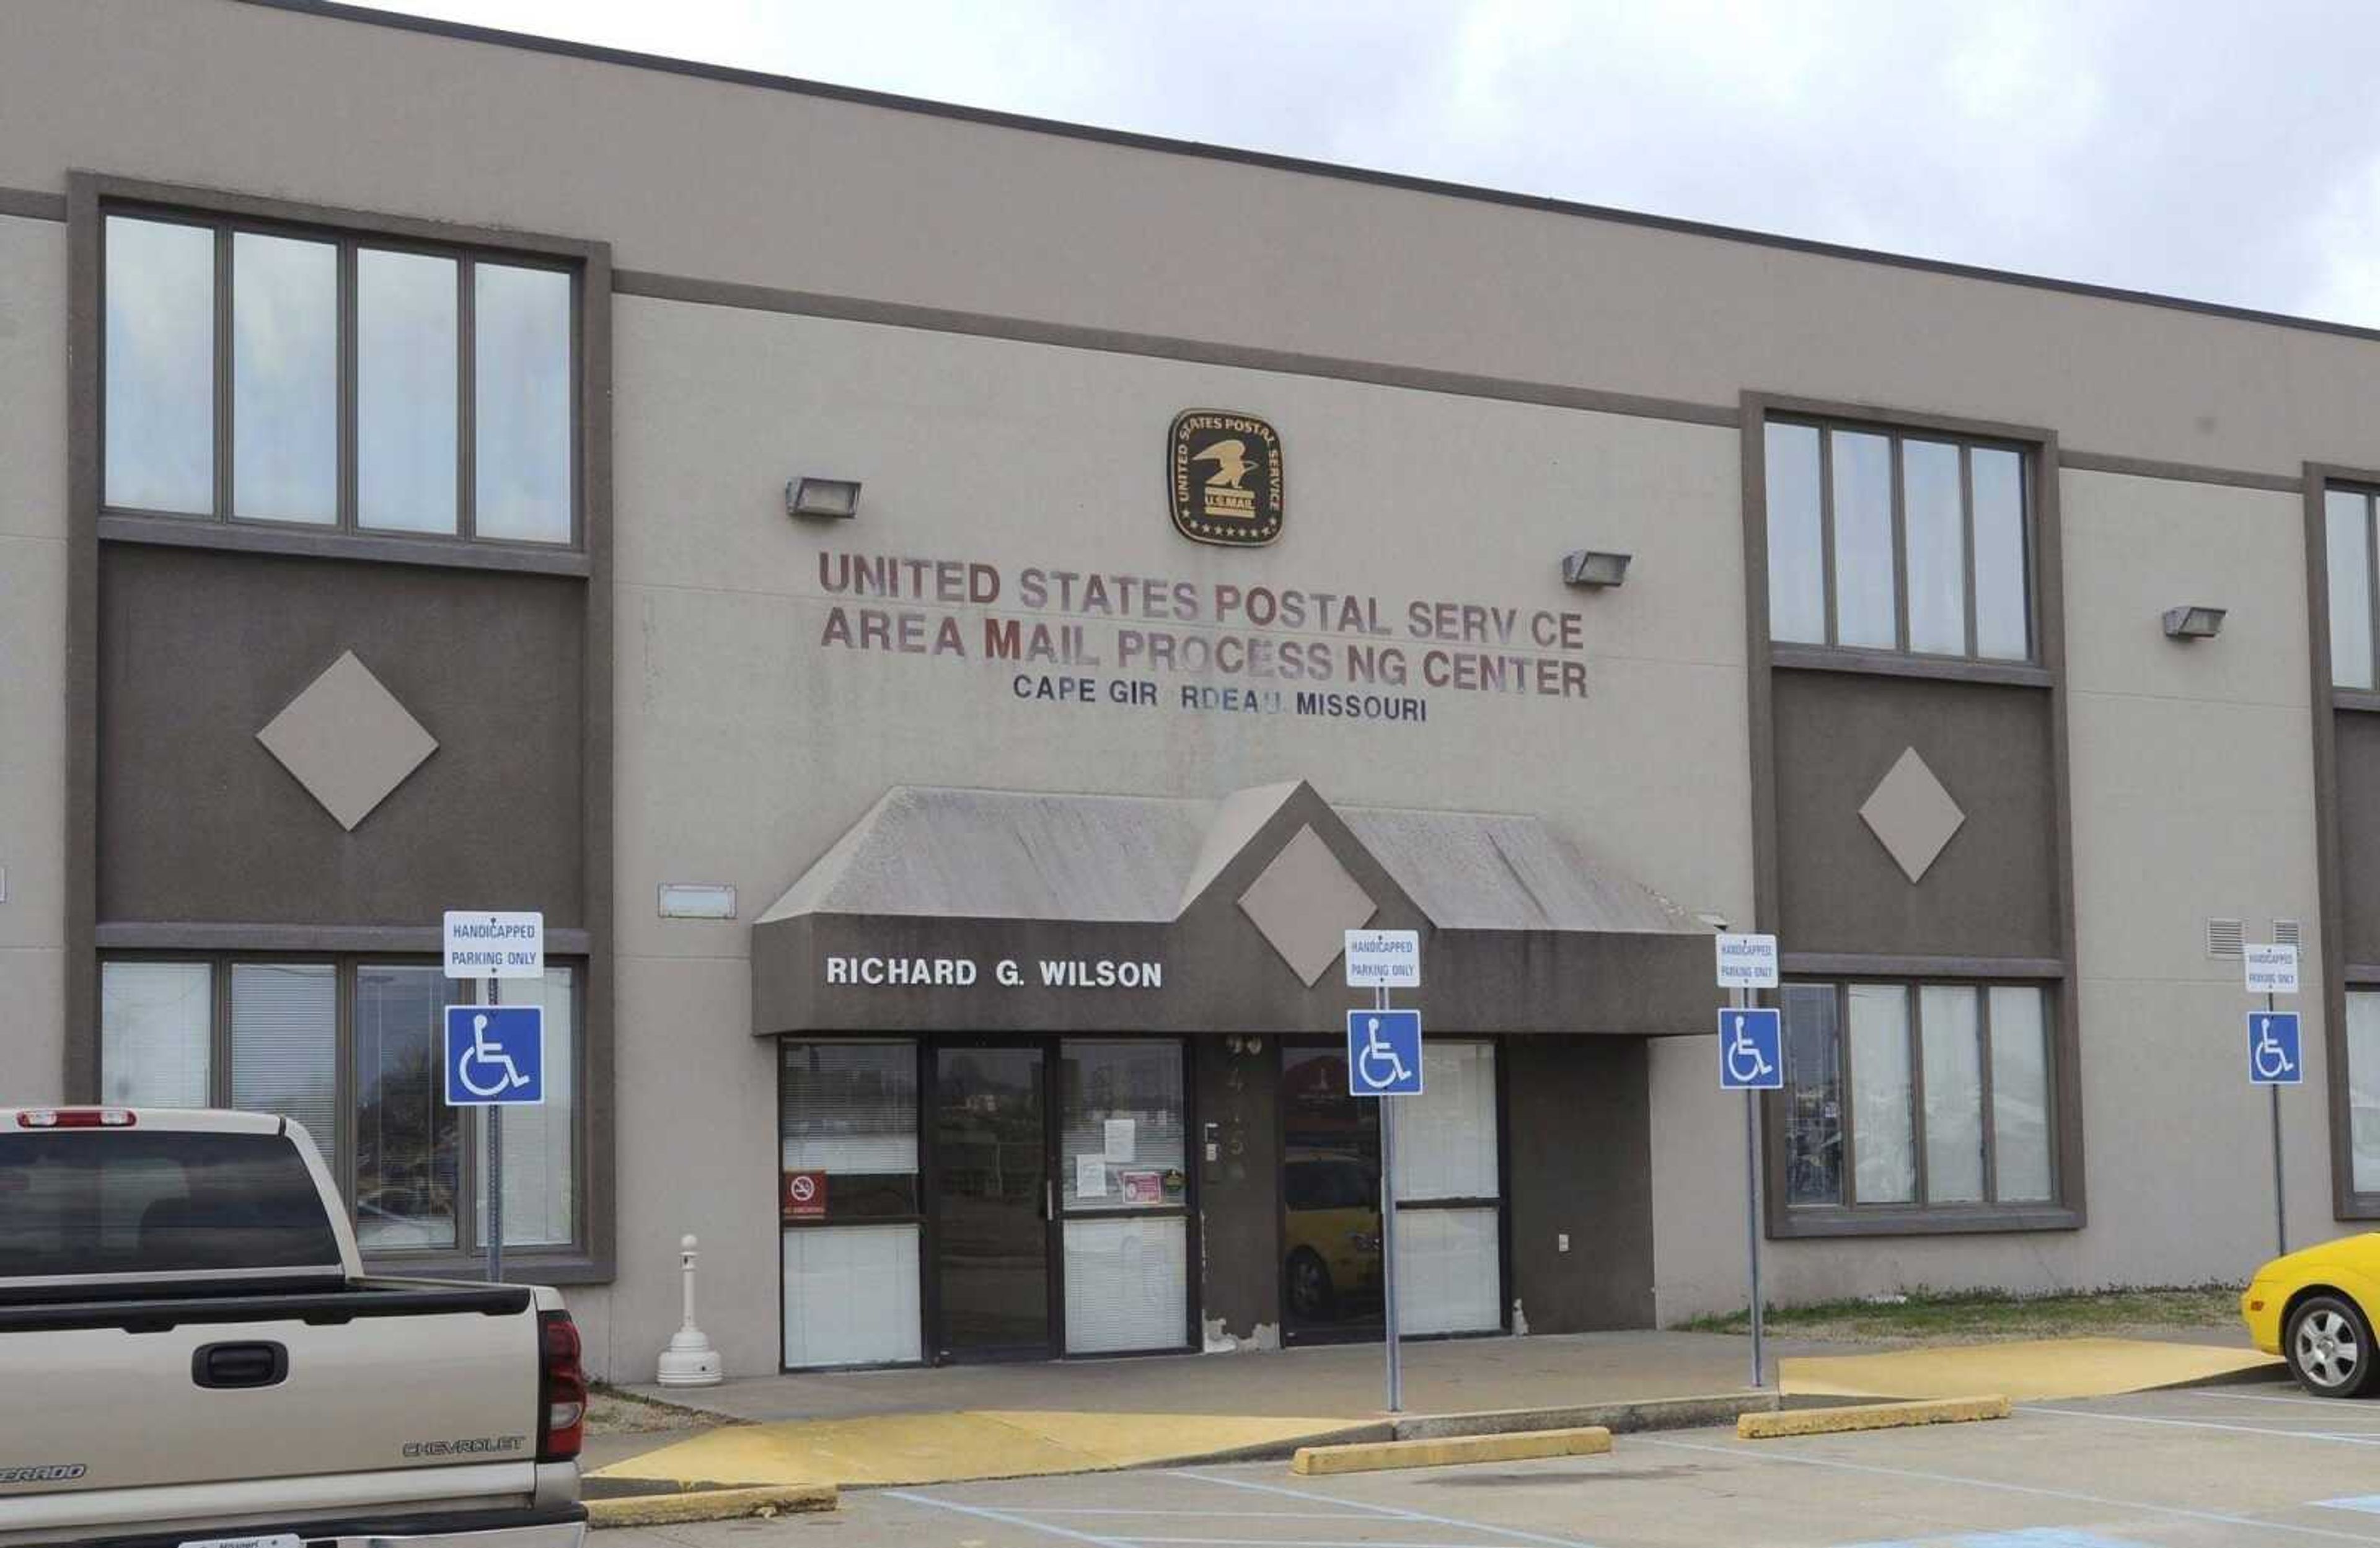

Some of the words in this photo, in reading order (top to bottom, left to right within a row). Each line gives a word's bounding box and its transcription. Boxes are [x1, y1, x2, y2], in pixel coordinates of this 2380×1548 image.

[1179, 417, 1222, 441] STATES
[1225, 418, 1274, 447] POSTAL
[1178, 444, 1189, 503] UNITED
[1269, 449, 1280, 511] SERVICE
[819, 552, 1000, 604] UNITED
[1020, 568, 1199, 620] STATES
[1215, 584, 1392, 635] POSTAL
[1408, 600, 1584, 649] SERVCE
[821, 607, 965, 656] AREA
[985, 618, 1100, 666] MAIL
[1118, 630, 1407, 685] PROCESSNG
[1424, 651, 1588, 698] CENTER
[1013, 674, 1095, 702] CAPE
[1109, 680, 1281, 713] GIRRDEAU
[1297, 692, 1426, 721] MISSOURI
[453, 924, 536, 939] HANDICAPPED
[1351, 940, 1413, 952] HANDICAPPED
[452, 951, 503, 965] PARKING
[508, 951, 537, 965] ONLY
[827, 957, 977, 985] RICHARD
[995, 959, 1025, 987] G.
[1039, 960, 1162, 988] WILSON
[1351, 964, 1389, 976] PARKING
[1391, 964, 1414, 977] ONLY
[403, 1436, 526, 1457] CHEVROLET
